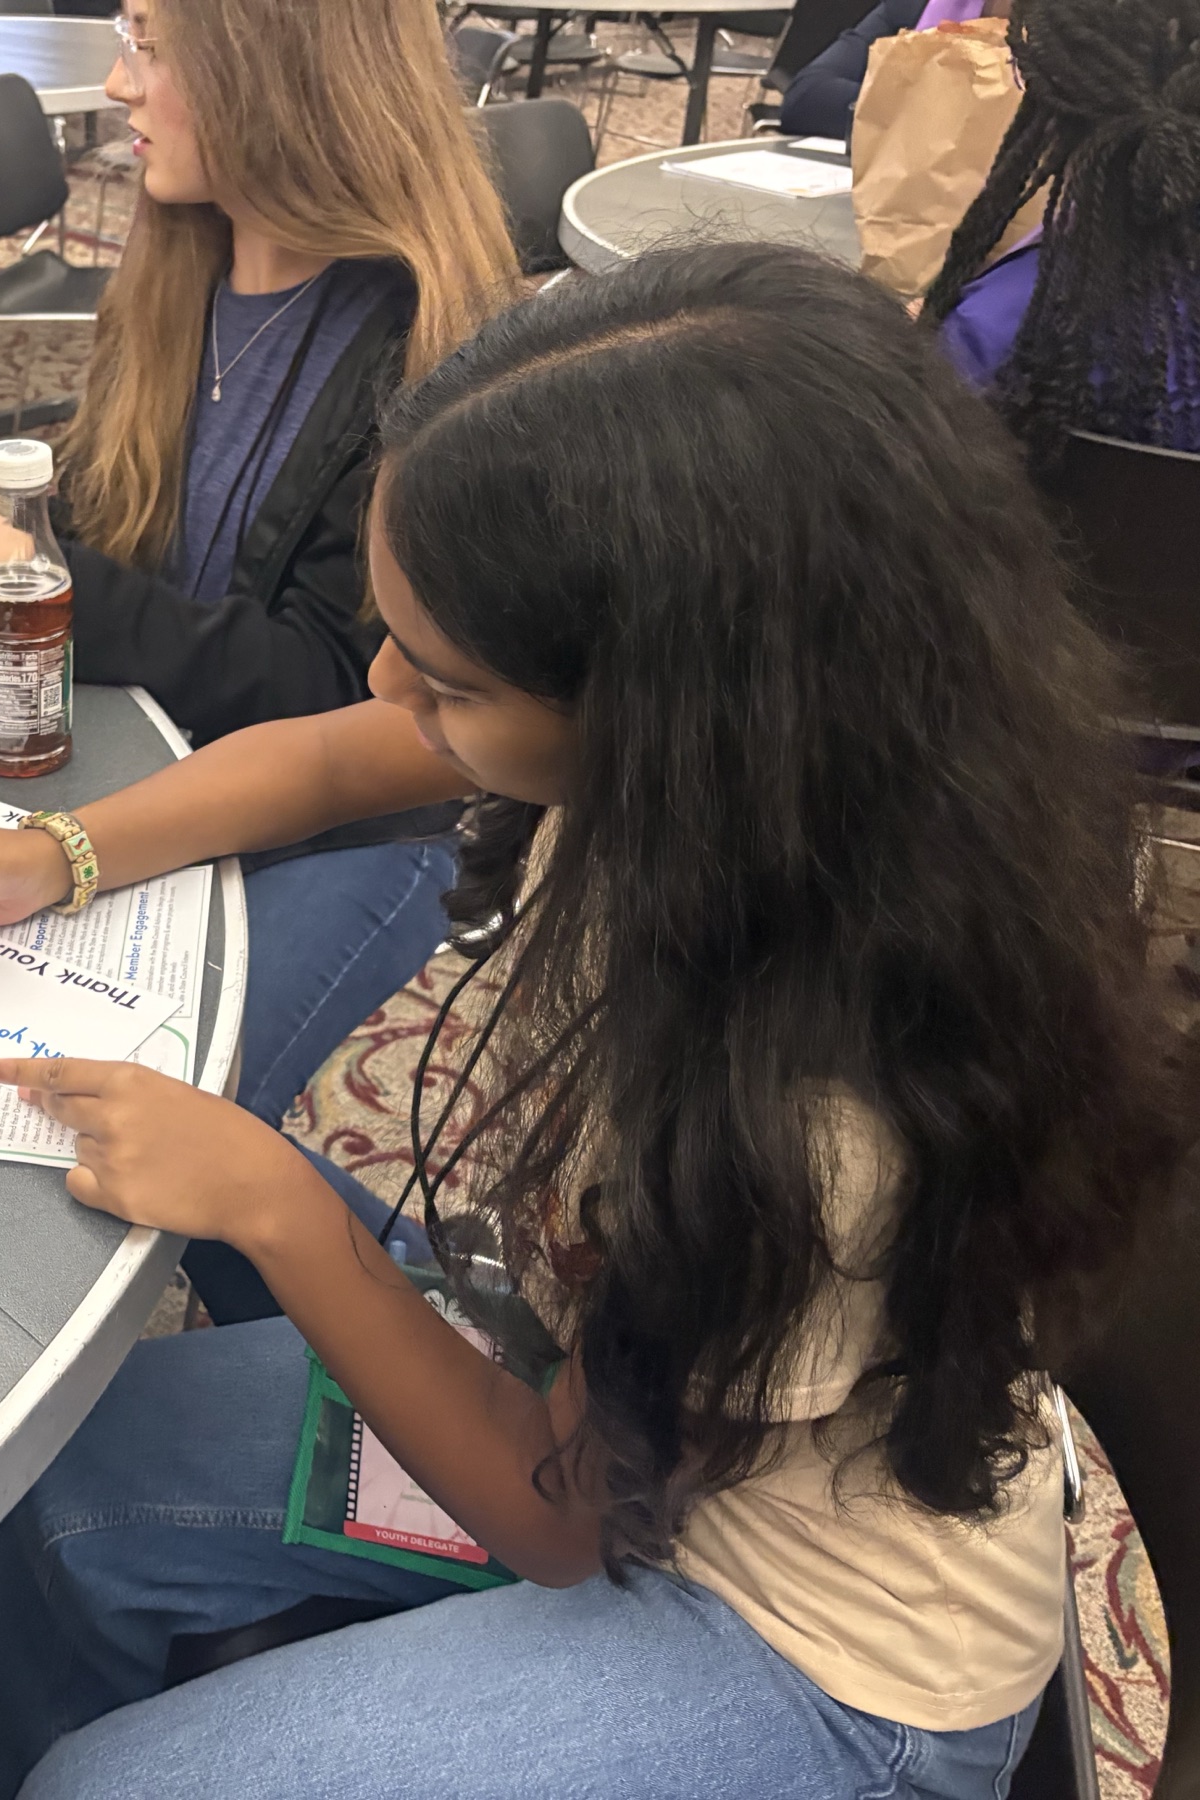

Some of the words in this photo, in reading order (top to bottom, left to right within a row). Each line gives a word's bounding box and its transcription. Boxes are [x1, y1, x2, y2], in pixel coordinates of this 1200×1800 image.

[21, 672, 37, 682] 170
[29, 913, 51, 953] Reporter
[129, 890, 149, 940] Engagement
[123, 941, 141, 980] Member
[56, 967, 140, 1009] Thank
[374, 1529, 408, 1544] YOUTH
[410, 1535, 460, 1554] DELEGATE
